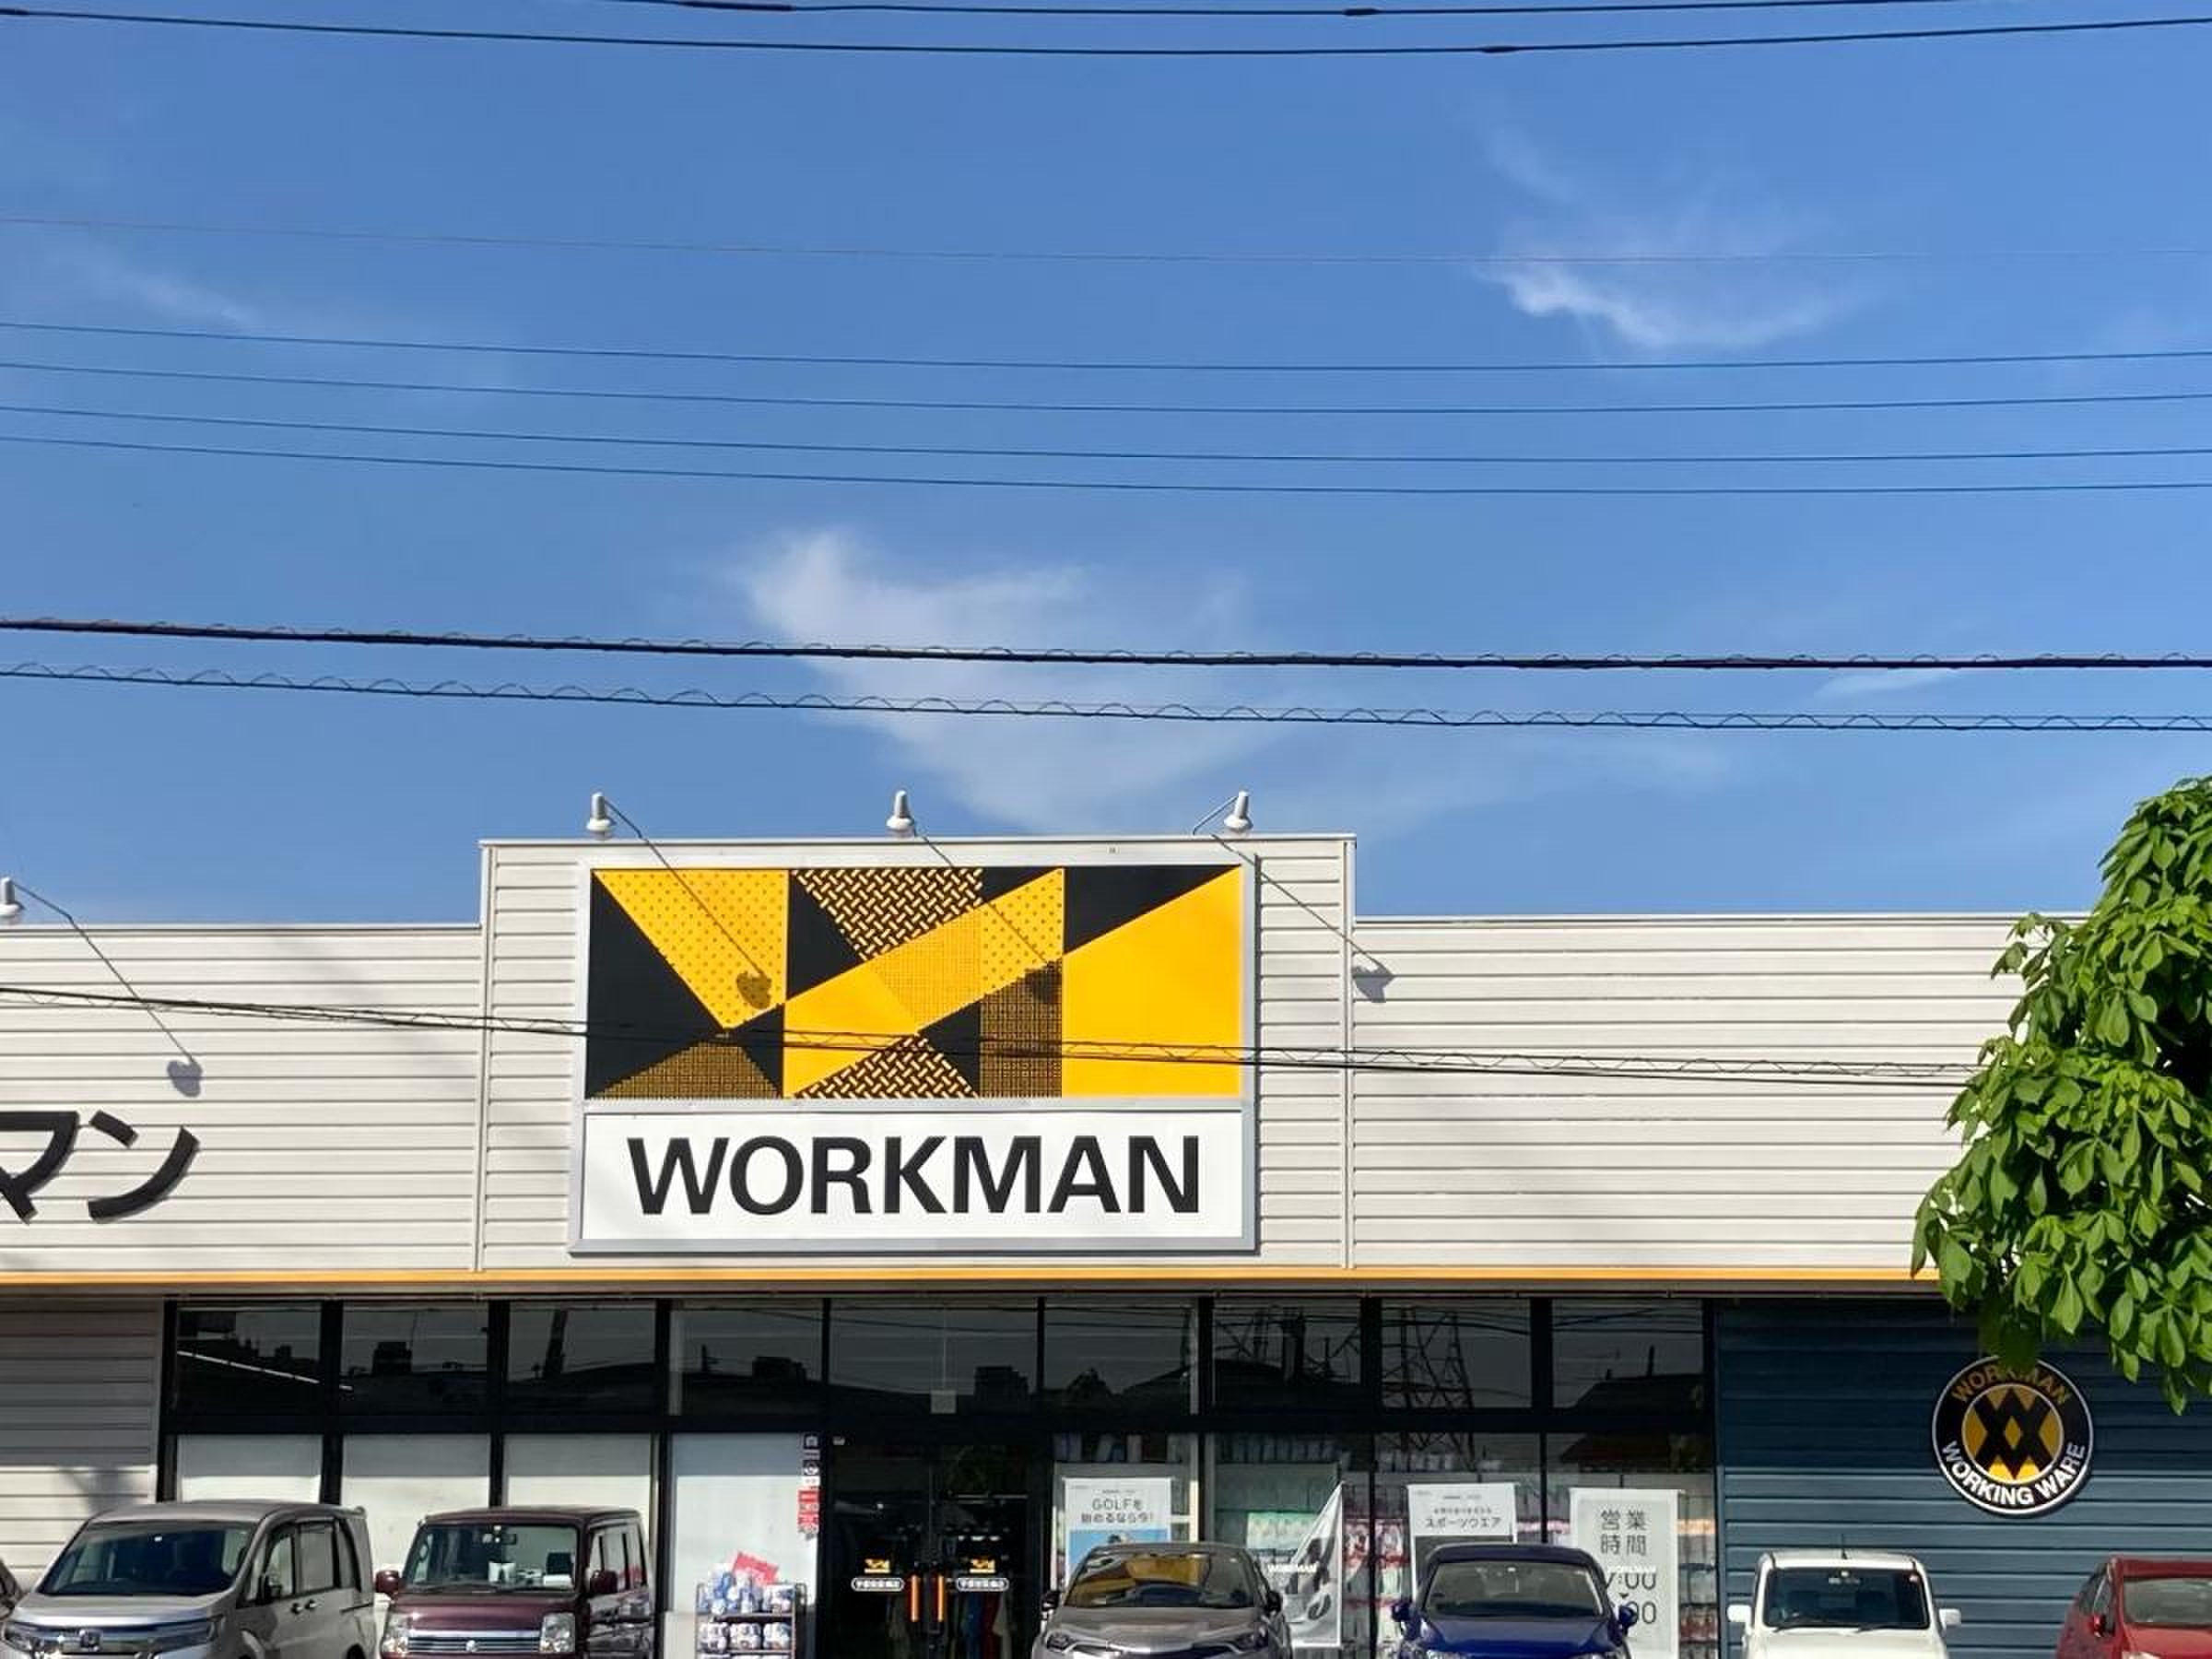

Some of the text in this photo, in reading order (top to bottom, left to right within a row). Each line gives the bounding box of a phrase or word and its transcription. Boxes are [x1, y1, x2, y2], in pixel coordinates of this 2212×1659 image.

[0, 1110, 201, 1224] マン
[626, 1135, 1200, 1216] WORKMAN
[1942, 1441, 2086, 1505] WORKING WARE
[1600, 1509, 1647, 1531] 営業
[1600, 1533, 1647, 1556] 時間
